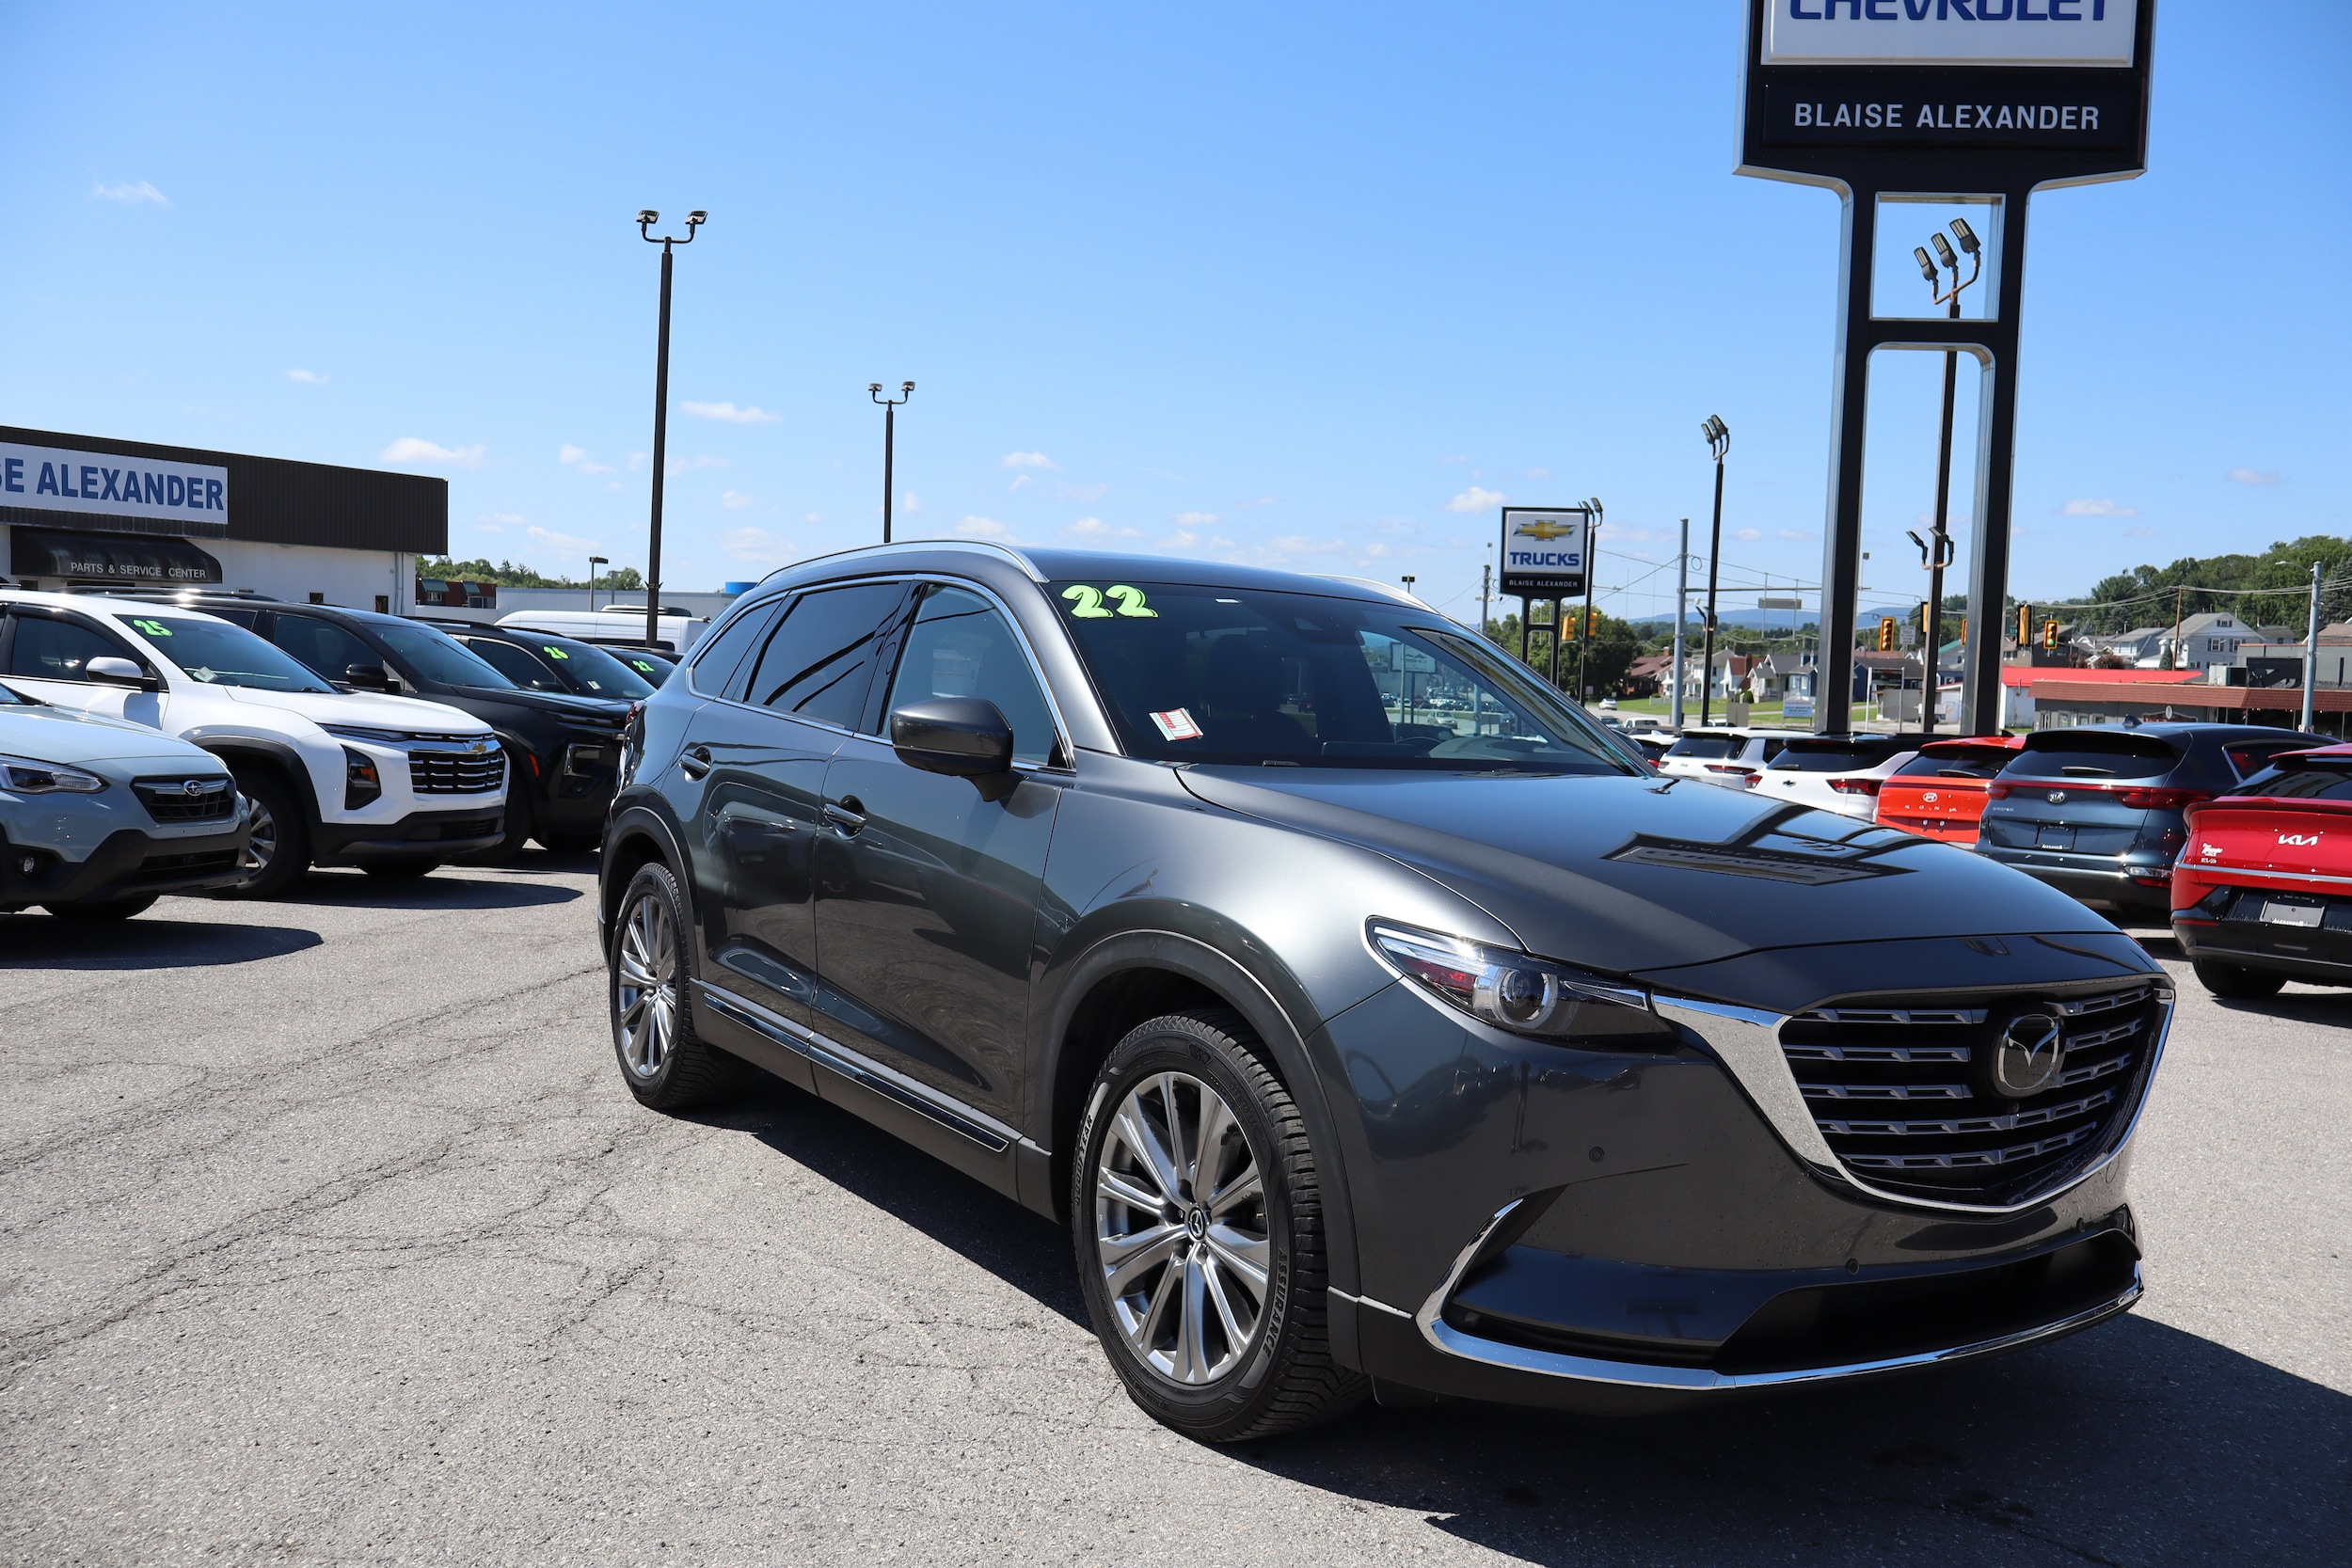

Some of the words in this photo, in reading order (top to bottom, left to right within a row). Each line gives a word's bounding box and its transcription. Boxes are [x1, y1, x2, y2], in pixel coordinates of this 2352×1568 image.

[1794, 103, 1903, 128] BLAISE
[1915, 104, 2099, 130] ALEXANDER
[36, 462, 224, 511] ALEXANDER
[1509, 551, 1580, 566] TRUCKS
[71, 562, 104, 574] PARTS
[107, 563, 116, 574] &
[119, 564, 162, 577] SERVICE
[167, 567, 206, 578] CENTER
[1061, 584, 1159, 618] 22
[133, 619, 173, 636] 25
[2278, 833, 2318, 847] KIA
[1263, 1247, 1288, 1359] ASSURANCE
